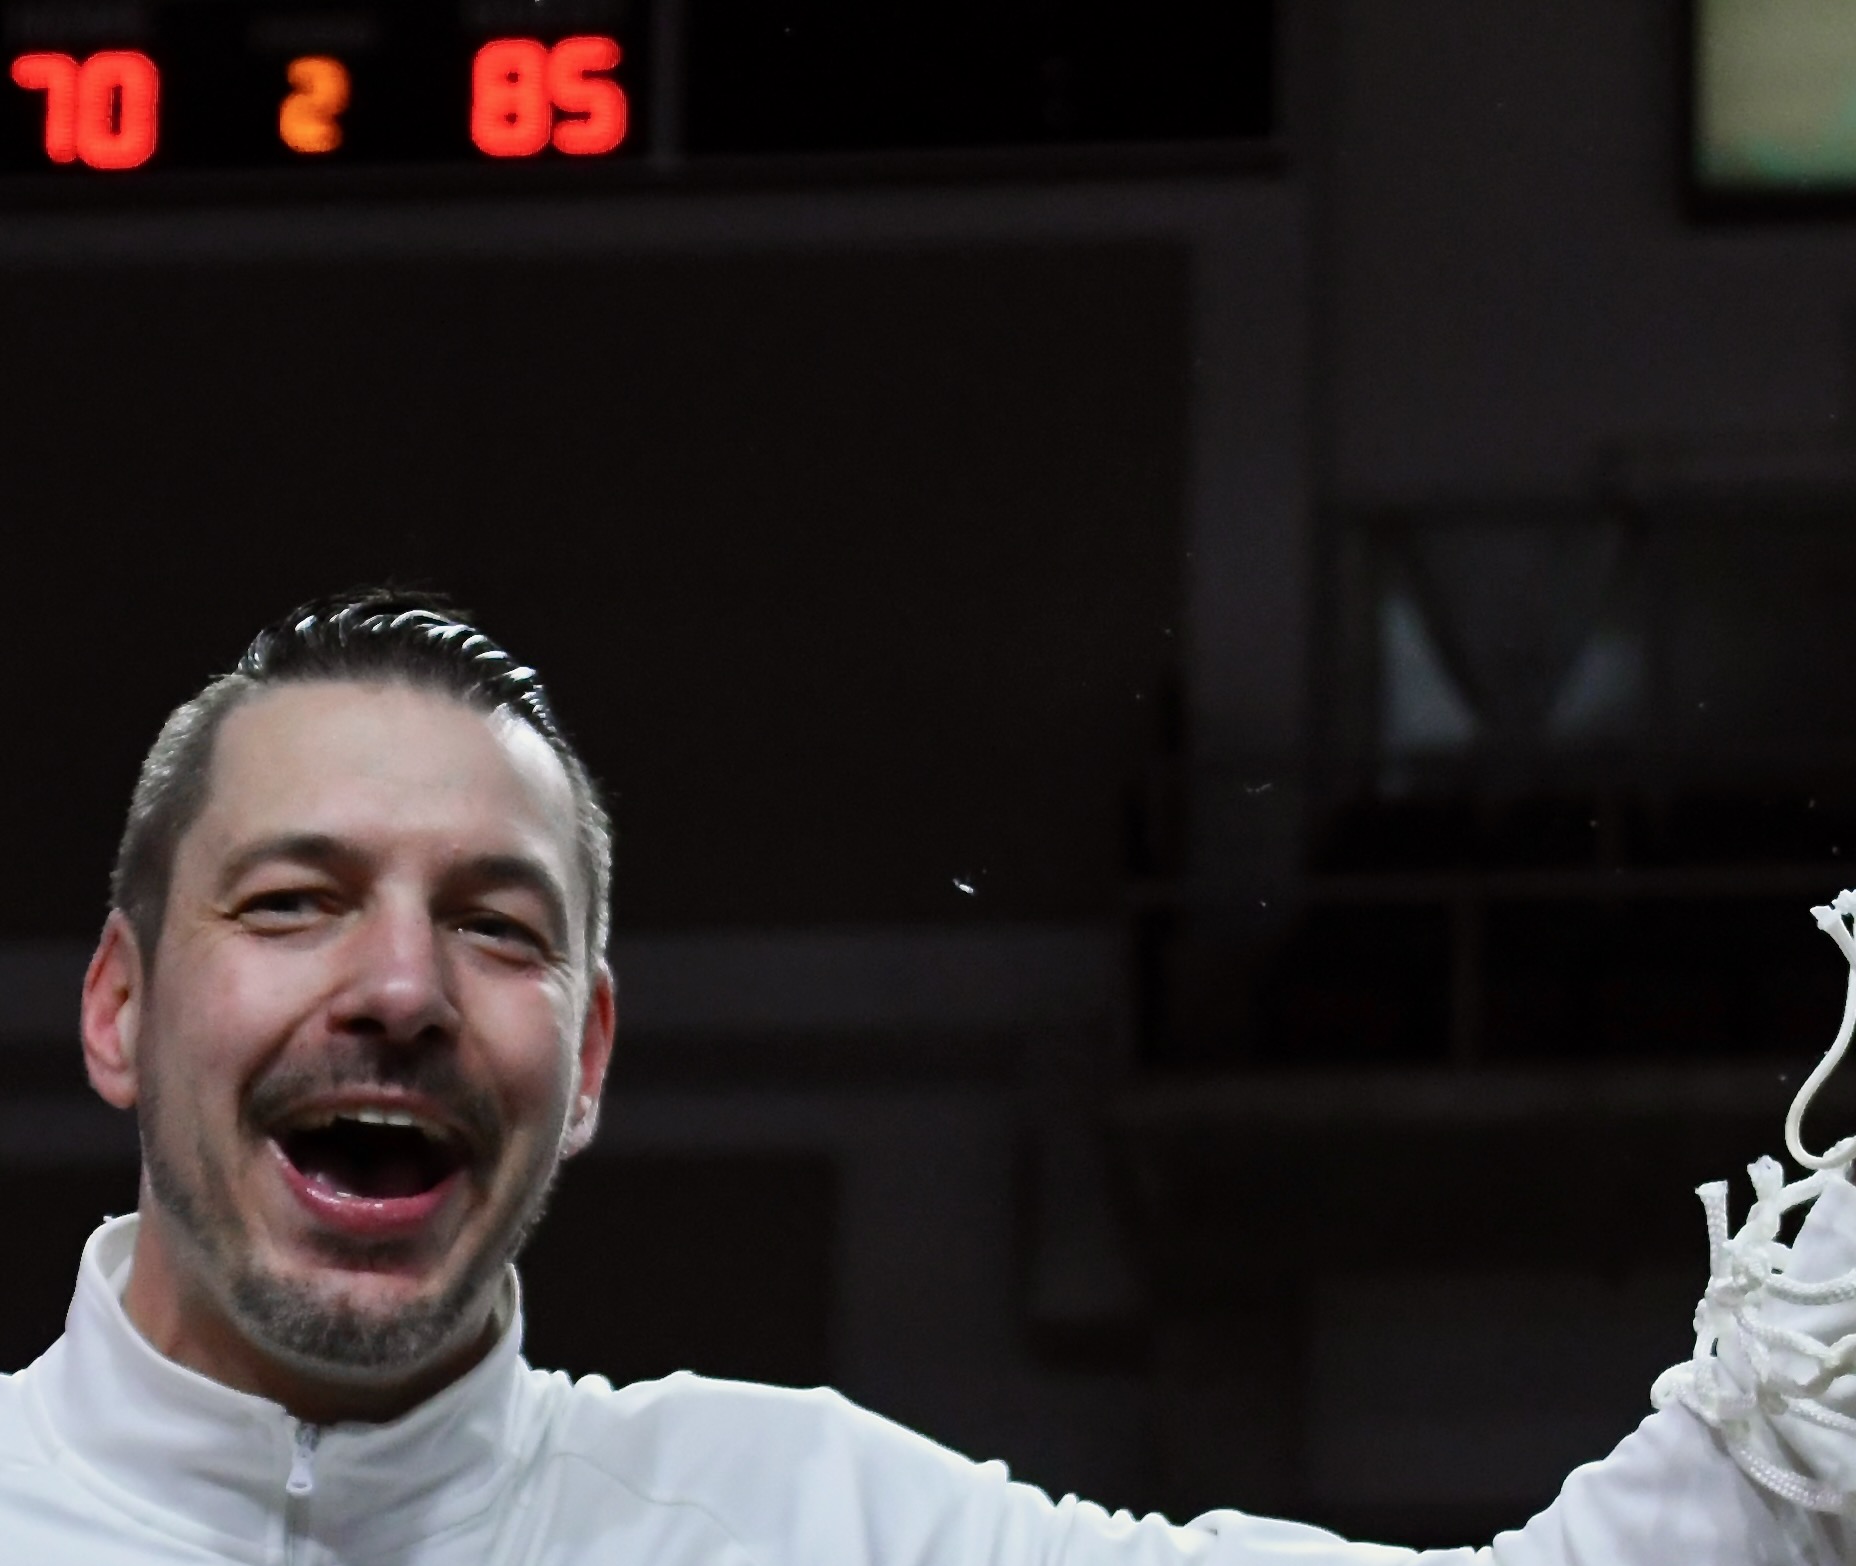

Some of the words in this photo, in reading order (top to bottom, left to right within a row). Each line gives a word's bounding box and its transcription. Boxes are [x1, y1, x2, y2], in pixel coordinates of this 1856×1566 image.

[10, 51, 158, 169] 70
[279, 55, 350, 153] 2
[471, 37, 627, 157] 85
